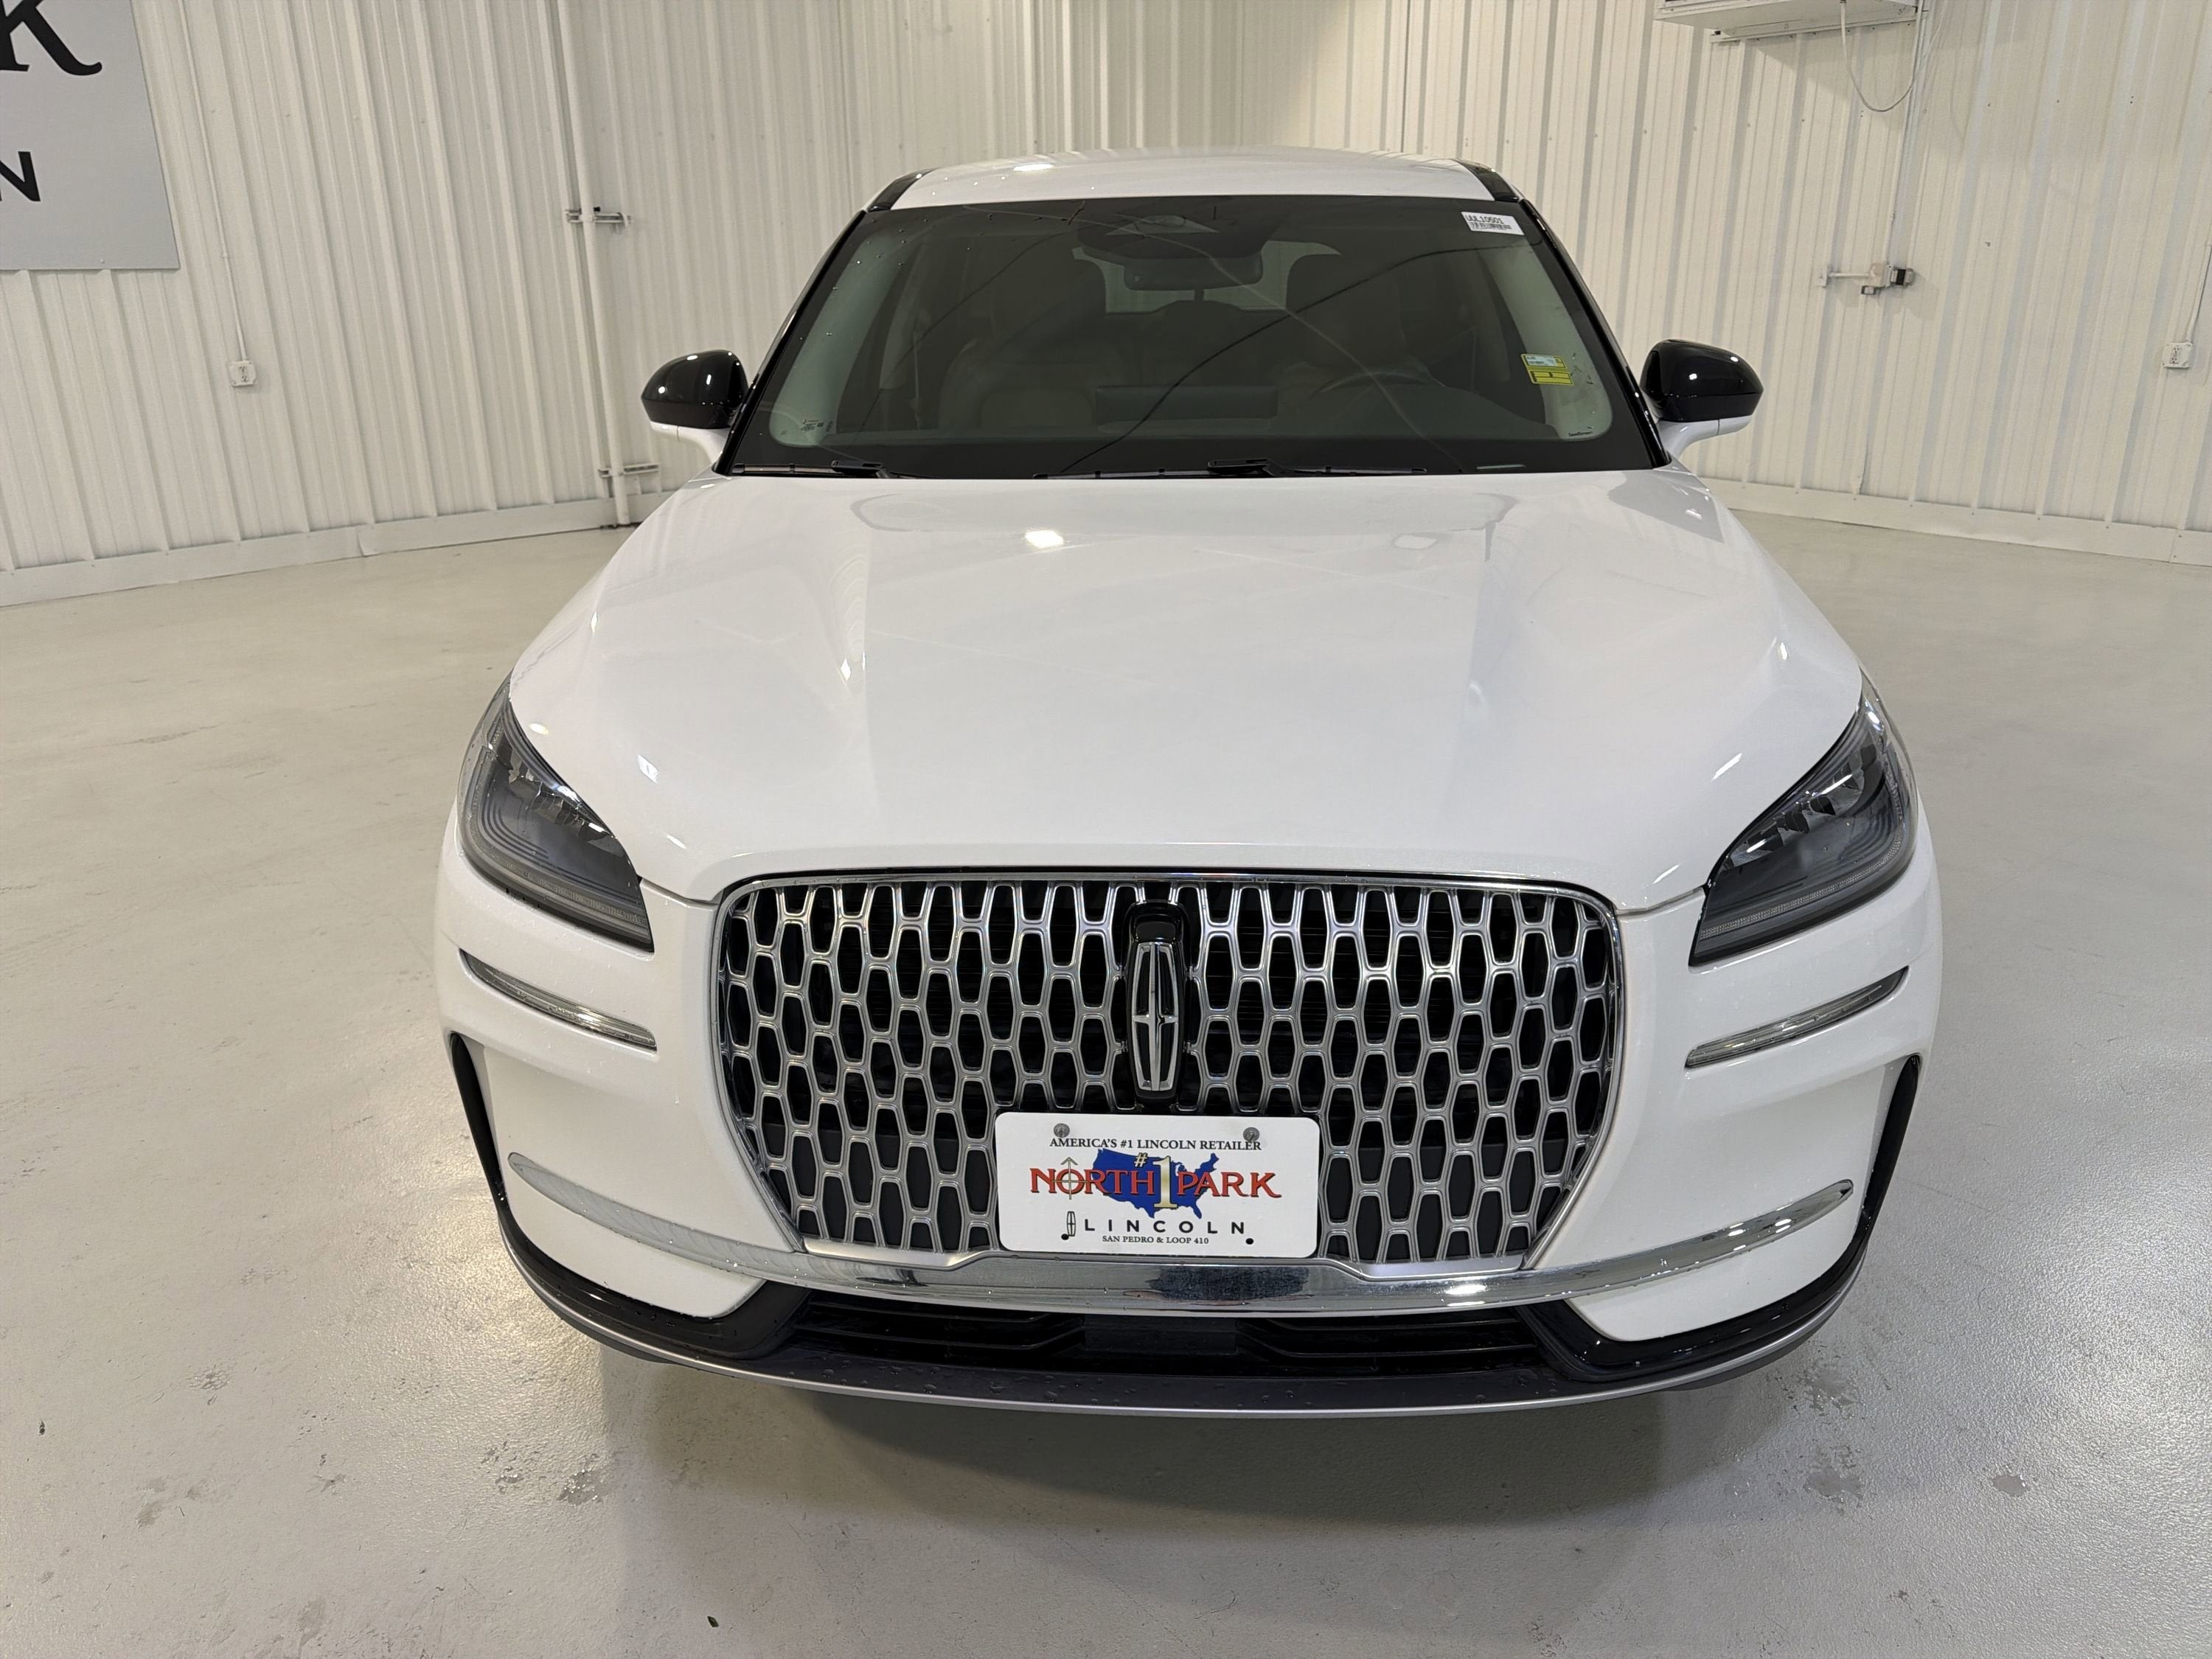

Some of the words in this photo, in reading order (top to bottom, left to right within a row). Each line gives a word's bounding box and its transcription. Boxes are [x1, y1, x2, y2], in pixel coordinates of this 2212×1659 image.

[1049, 1138, 1117, 1148] AMERICA'S
[1120, 1139, 1133, 1149] #1
[1137, 1140, 1196, 1150] LINCOLN
[1200, 1141, 1262, 1151] RETAILER
[1029, 1168, 1155, 1196] NORTH
[1177, 1171, 1282, 1199] PARK
[1085, 1219, 1245, 1234] LINCOLN
[1102, 1235, 1120, 1243] SAN
[1123, 1236, 1154, 1244] PEDRO
[1166, 1237, 1191, 1245] LOOP
